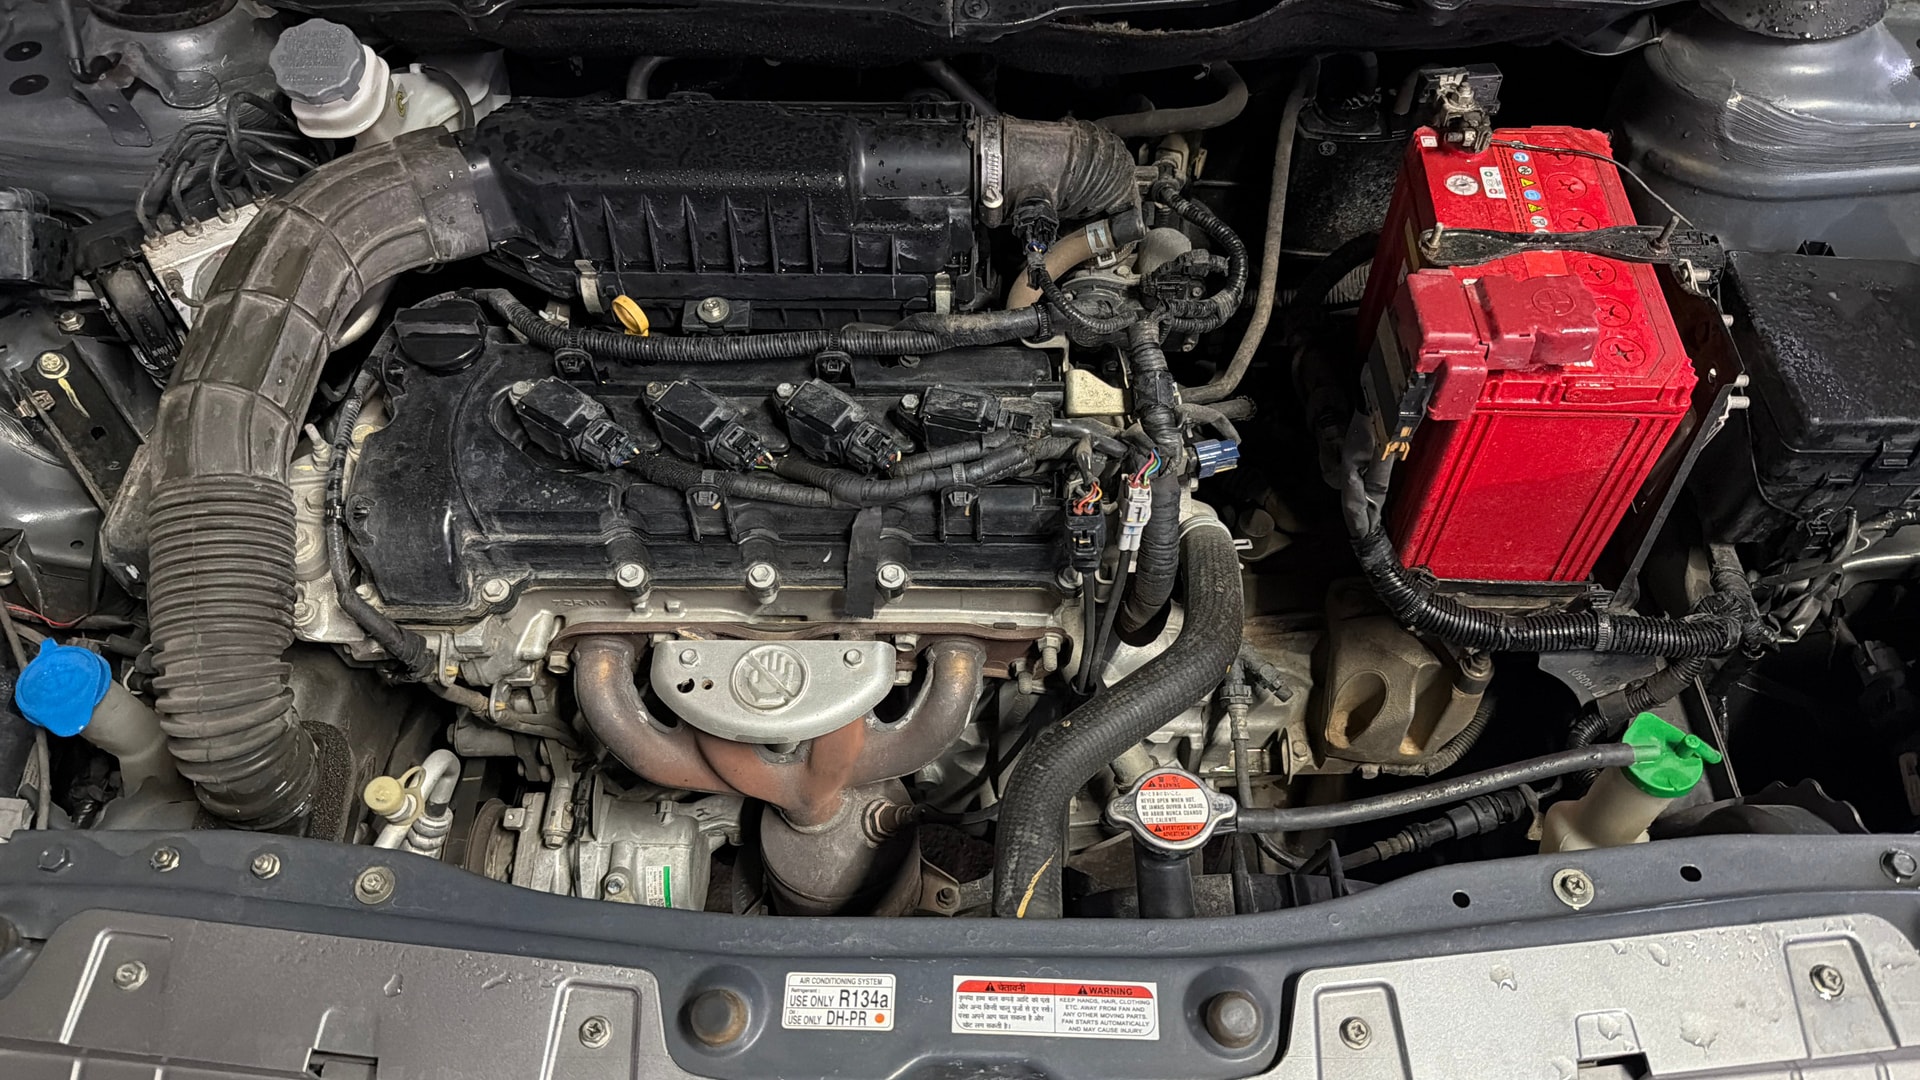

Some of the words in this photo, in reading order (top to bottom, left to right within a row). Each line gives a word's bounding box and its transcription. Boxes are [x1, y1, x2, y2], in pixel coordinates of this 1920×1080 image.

[790, 995, 808, 1006] USE
[810, 996, 834, 1007] ONLY
[839, 989, 888, 1008] R134a
[1089, 987, 1133, 995] WARNING
[788, 1015, 802, 1024] USE
[803, 1016, 822, 1025] ONLY
[827, 1010, 867, 1025] DH-PR
